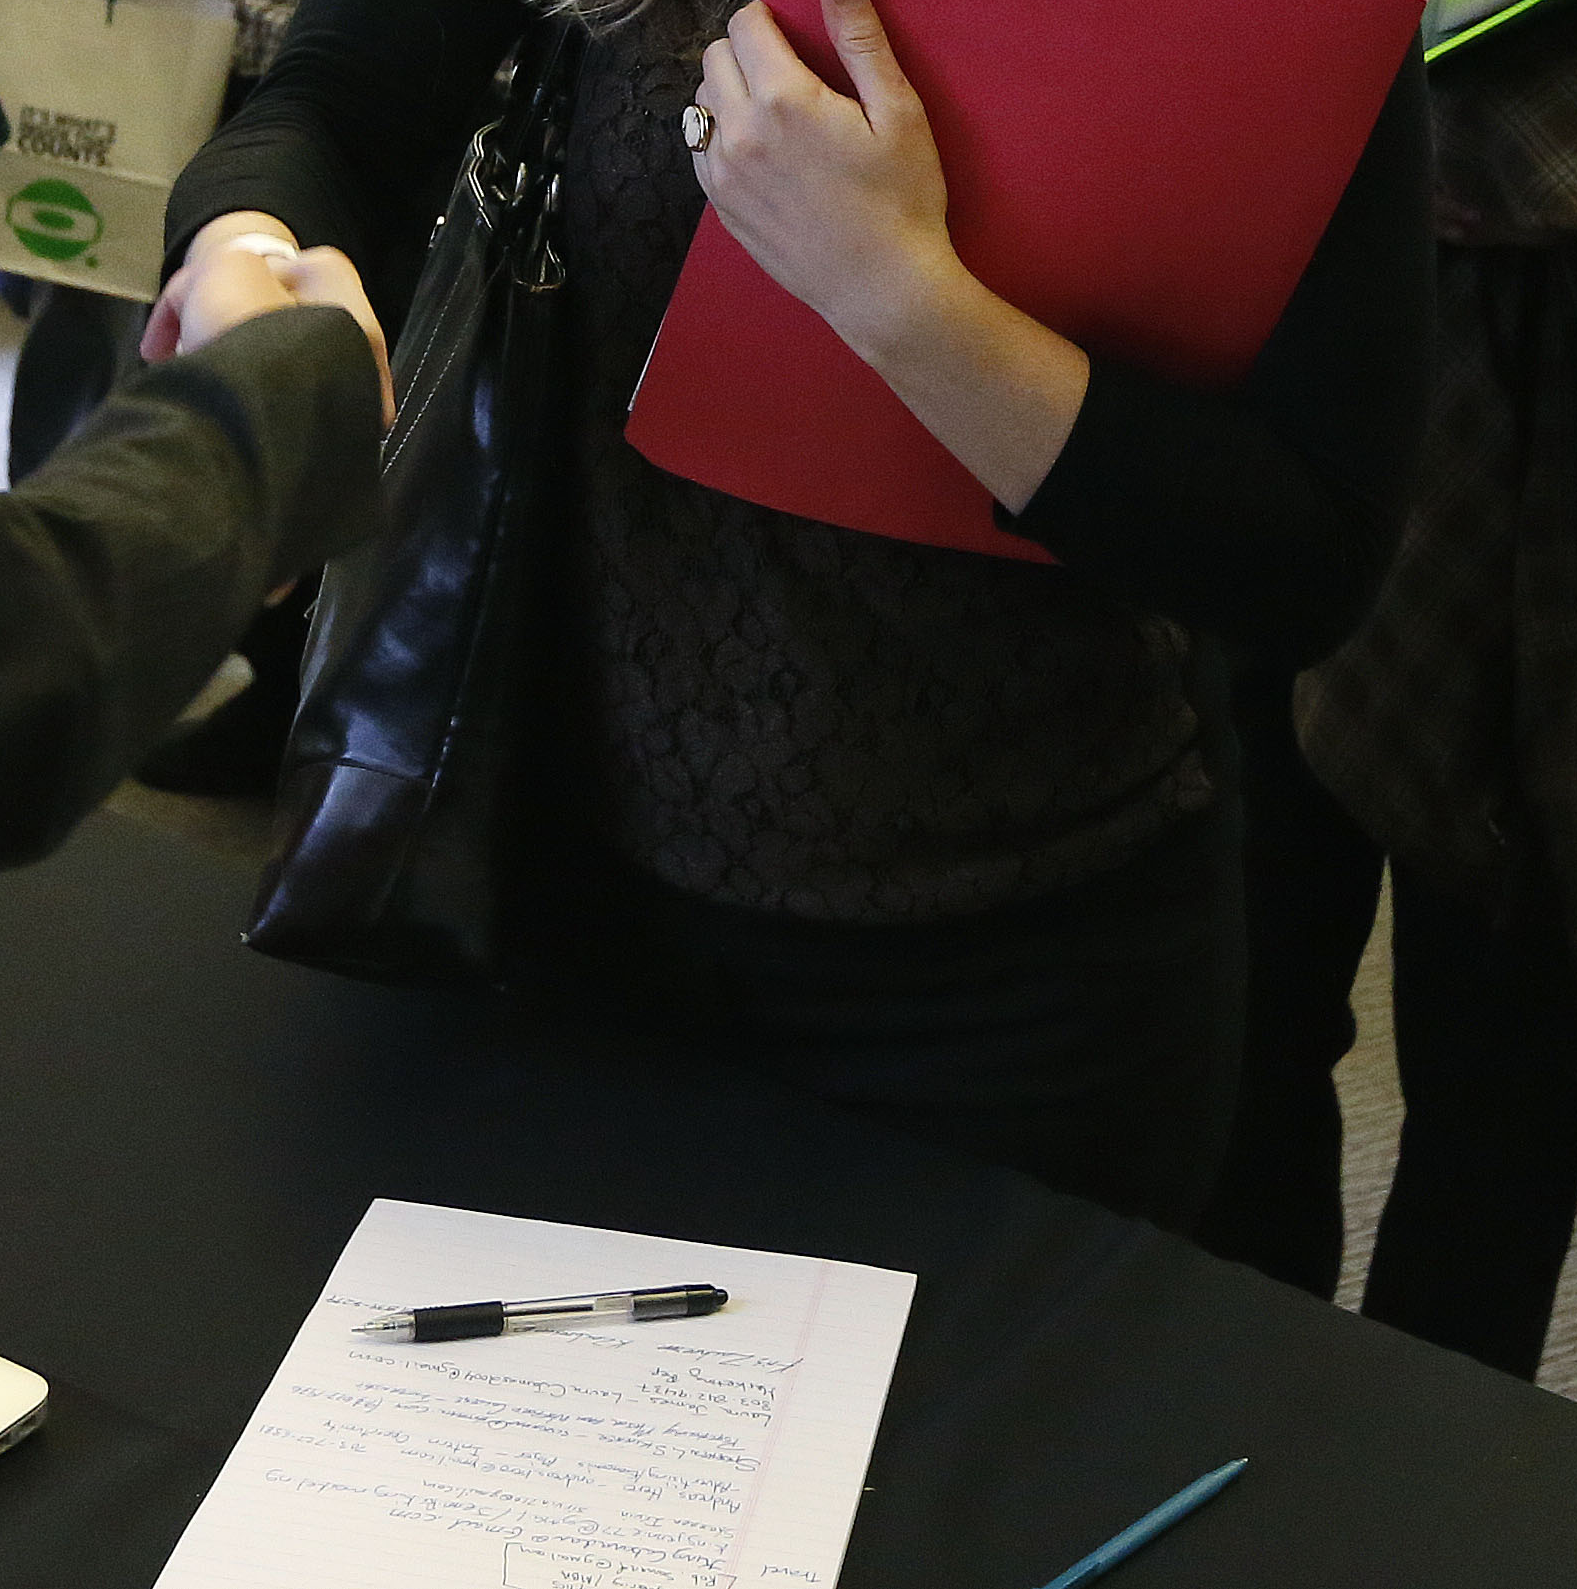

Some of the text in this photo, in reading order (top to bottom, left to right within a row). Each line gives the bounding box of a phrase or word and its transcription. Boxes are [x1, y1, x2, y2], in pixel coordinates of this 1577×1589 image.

[688, 1367, 777, 1402] Marketing
[647, 1395, 709, 1417] James
[718, 1406, 775, 1428] Laura
